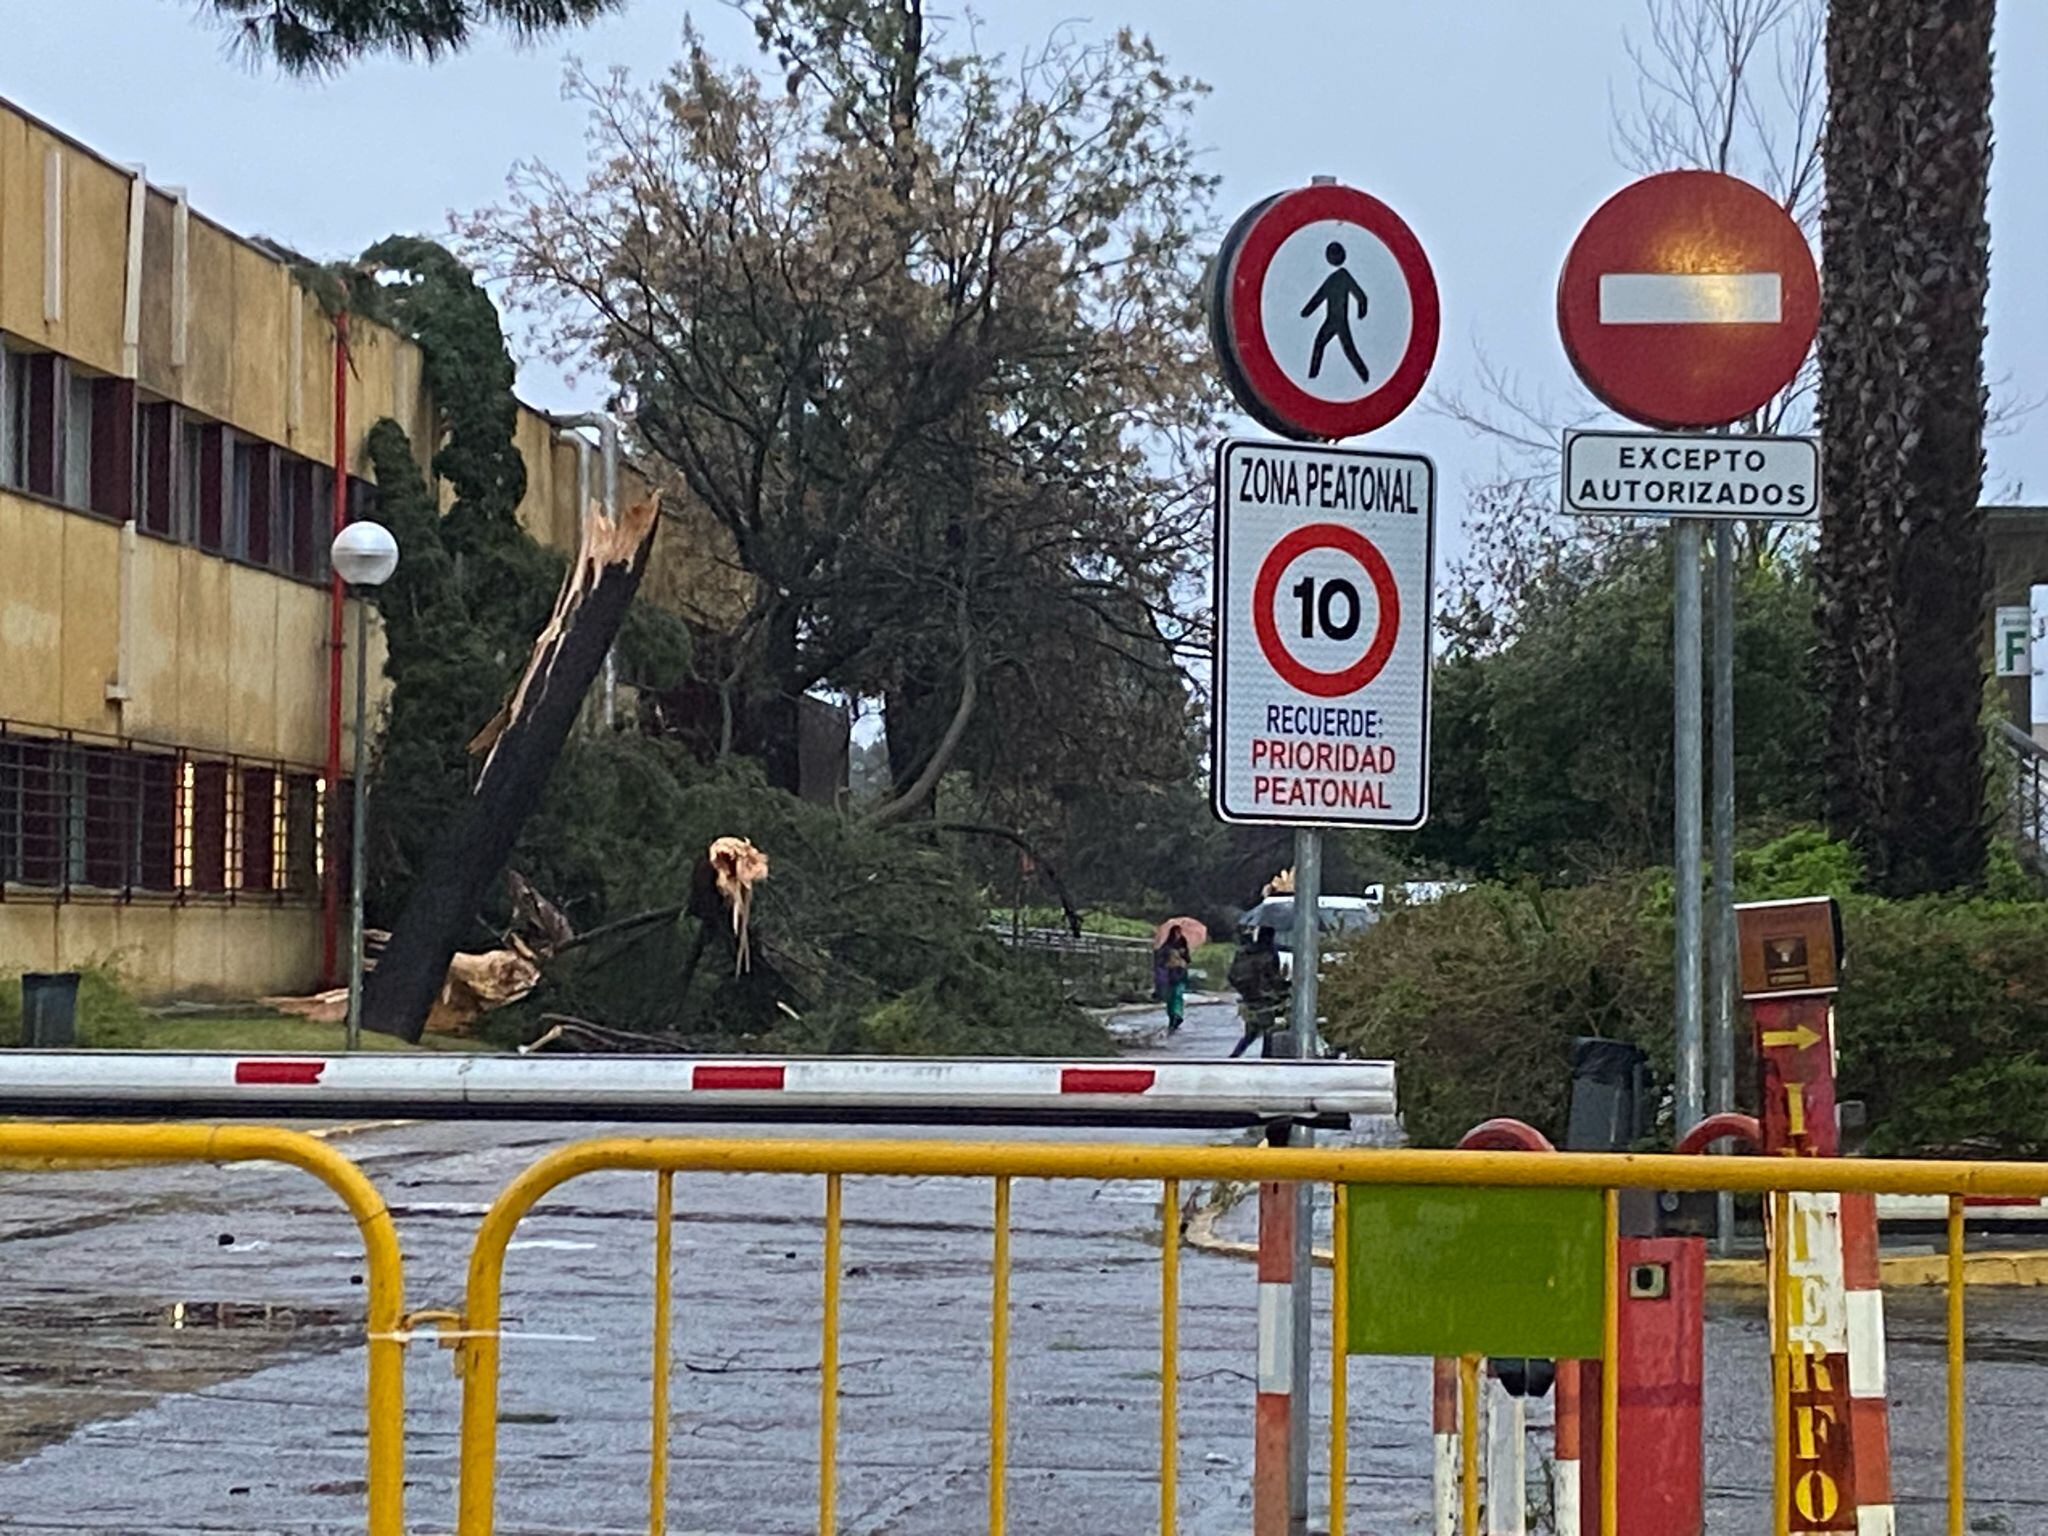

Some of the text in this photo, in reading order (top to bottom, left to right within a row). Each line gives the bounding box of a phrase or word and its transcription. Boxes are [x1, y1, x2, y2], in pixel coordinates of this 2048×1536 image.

[1619, 447, 1765, 471] EXCEPTO
[1240, 457, 1418, 514] ZONA PEATONAL
[1579, 479, 1806, 506] AUTORIZADOS
[1293, 576, 1361, 641] 10
[2006, 631, 2026, 671] F
[1252, 739, 1396, 774] PRIORIDAD
[1254, 776, 1392, 809] PEATONAL
